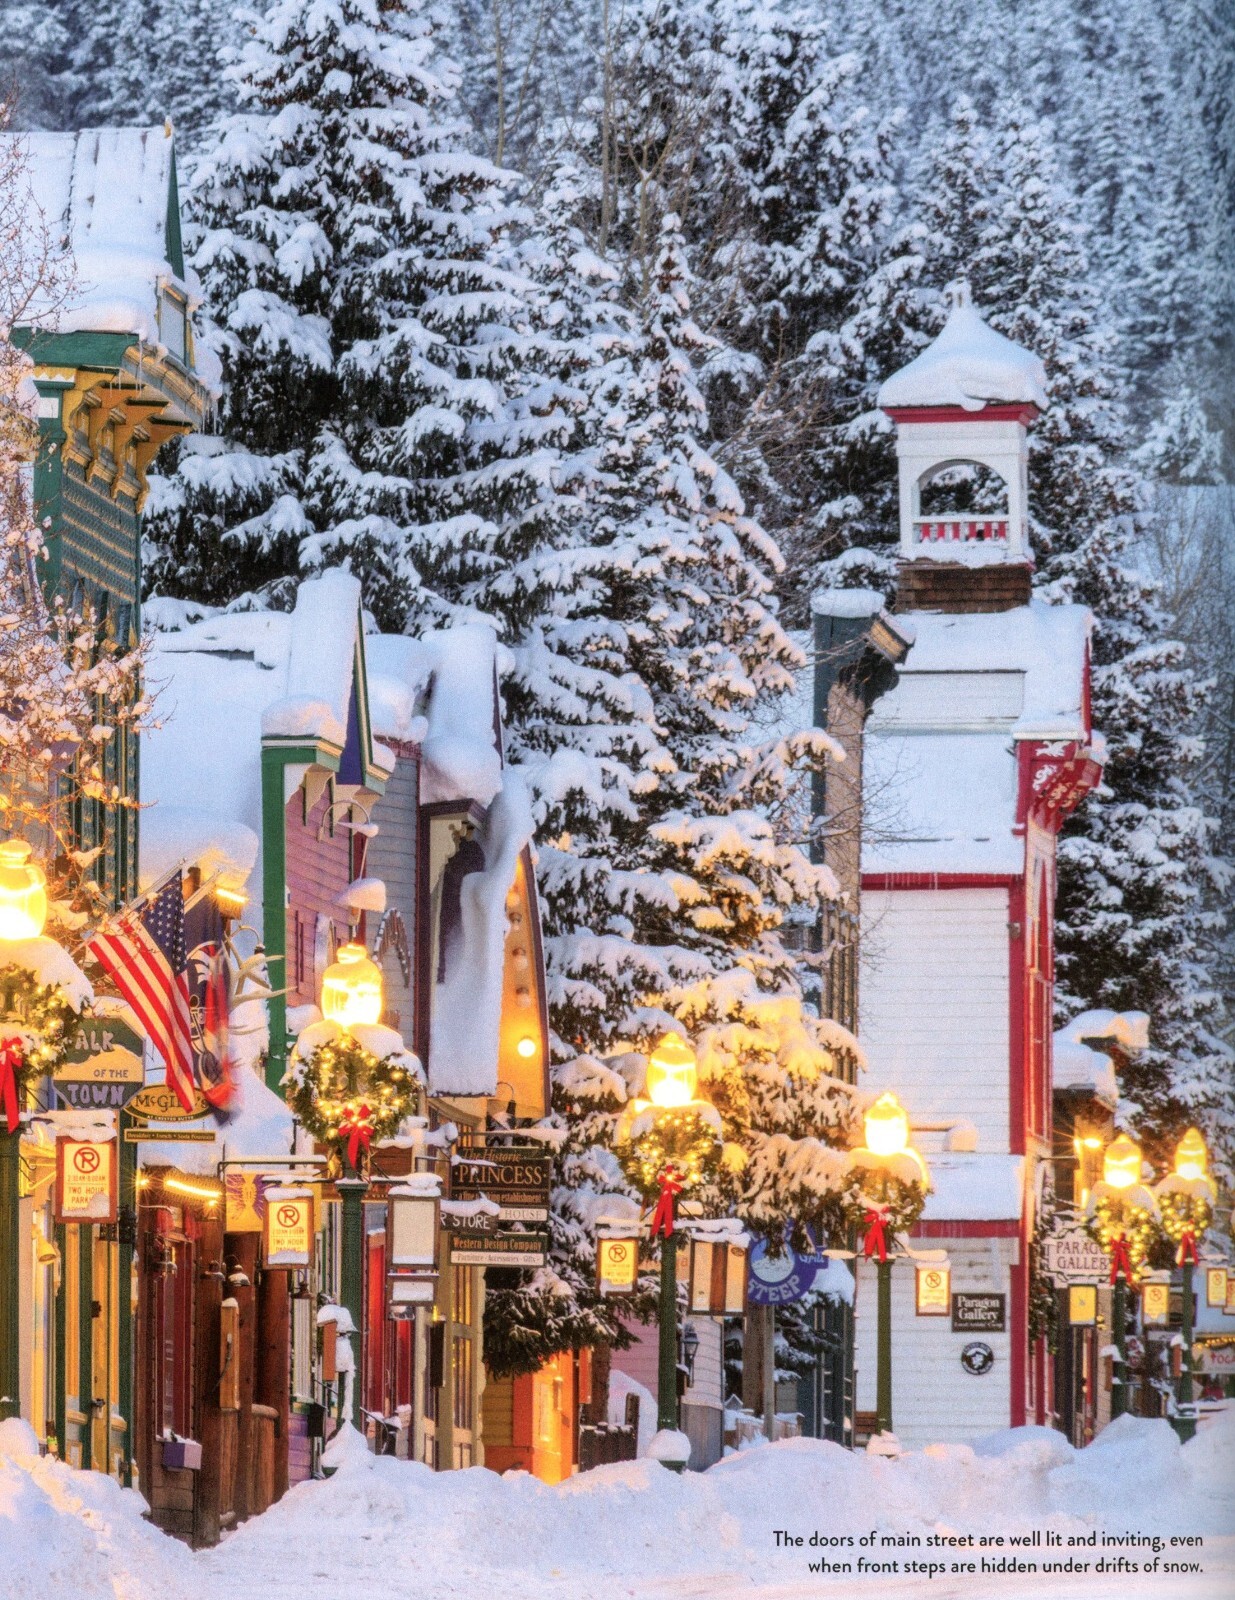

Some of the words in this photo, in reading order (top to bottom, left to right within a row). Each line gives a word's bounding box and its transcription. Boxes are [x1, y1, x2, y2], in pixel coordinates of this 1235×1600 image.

[75, 1029, 114, 1051] ALK
[93, 1069, 106, 1078] OF
[109, 1069, 129, 1078] THE
[67, 1084, 125, 1105] TOWN
[463, 1148, 481, 1160] The
[482, 1148, 521, 1162] Historic
[459, 1164, 542, 1185] PRINCESS
[68, 1186, 82, 1194] TWO
[504, 1209, 544, 1219] HOUSE
[452, 1214, 491, 1229] STORE
[453, 1236, 481, 1249] Western
[484, 1238, 508, 1251] Design
[510, 1239, 542, 1252] Company
[957, 1295, 1000, 1309] Paragon
[958, 1308, 998, 1322] Gallery
